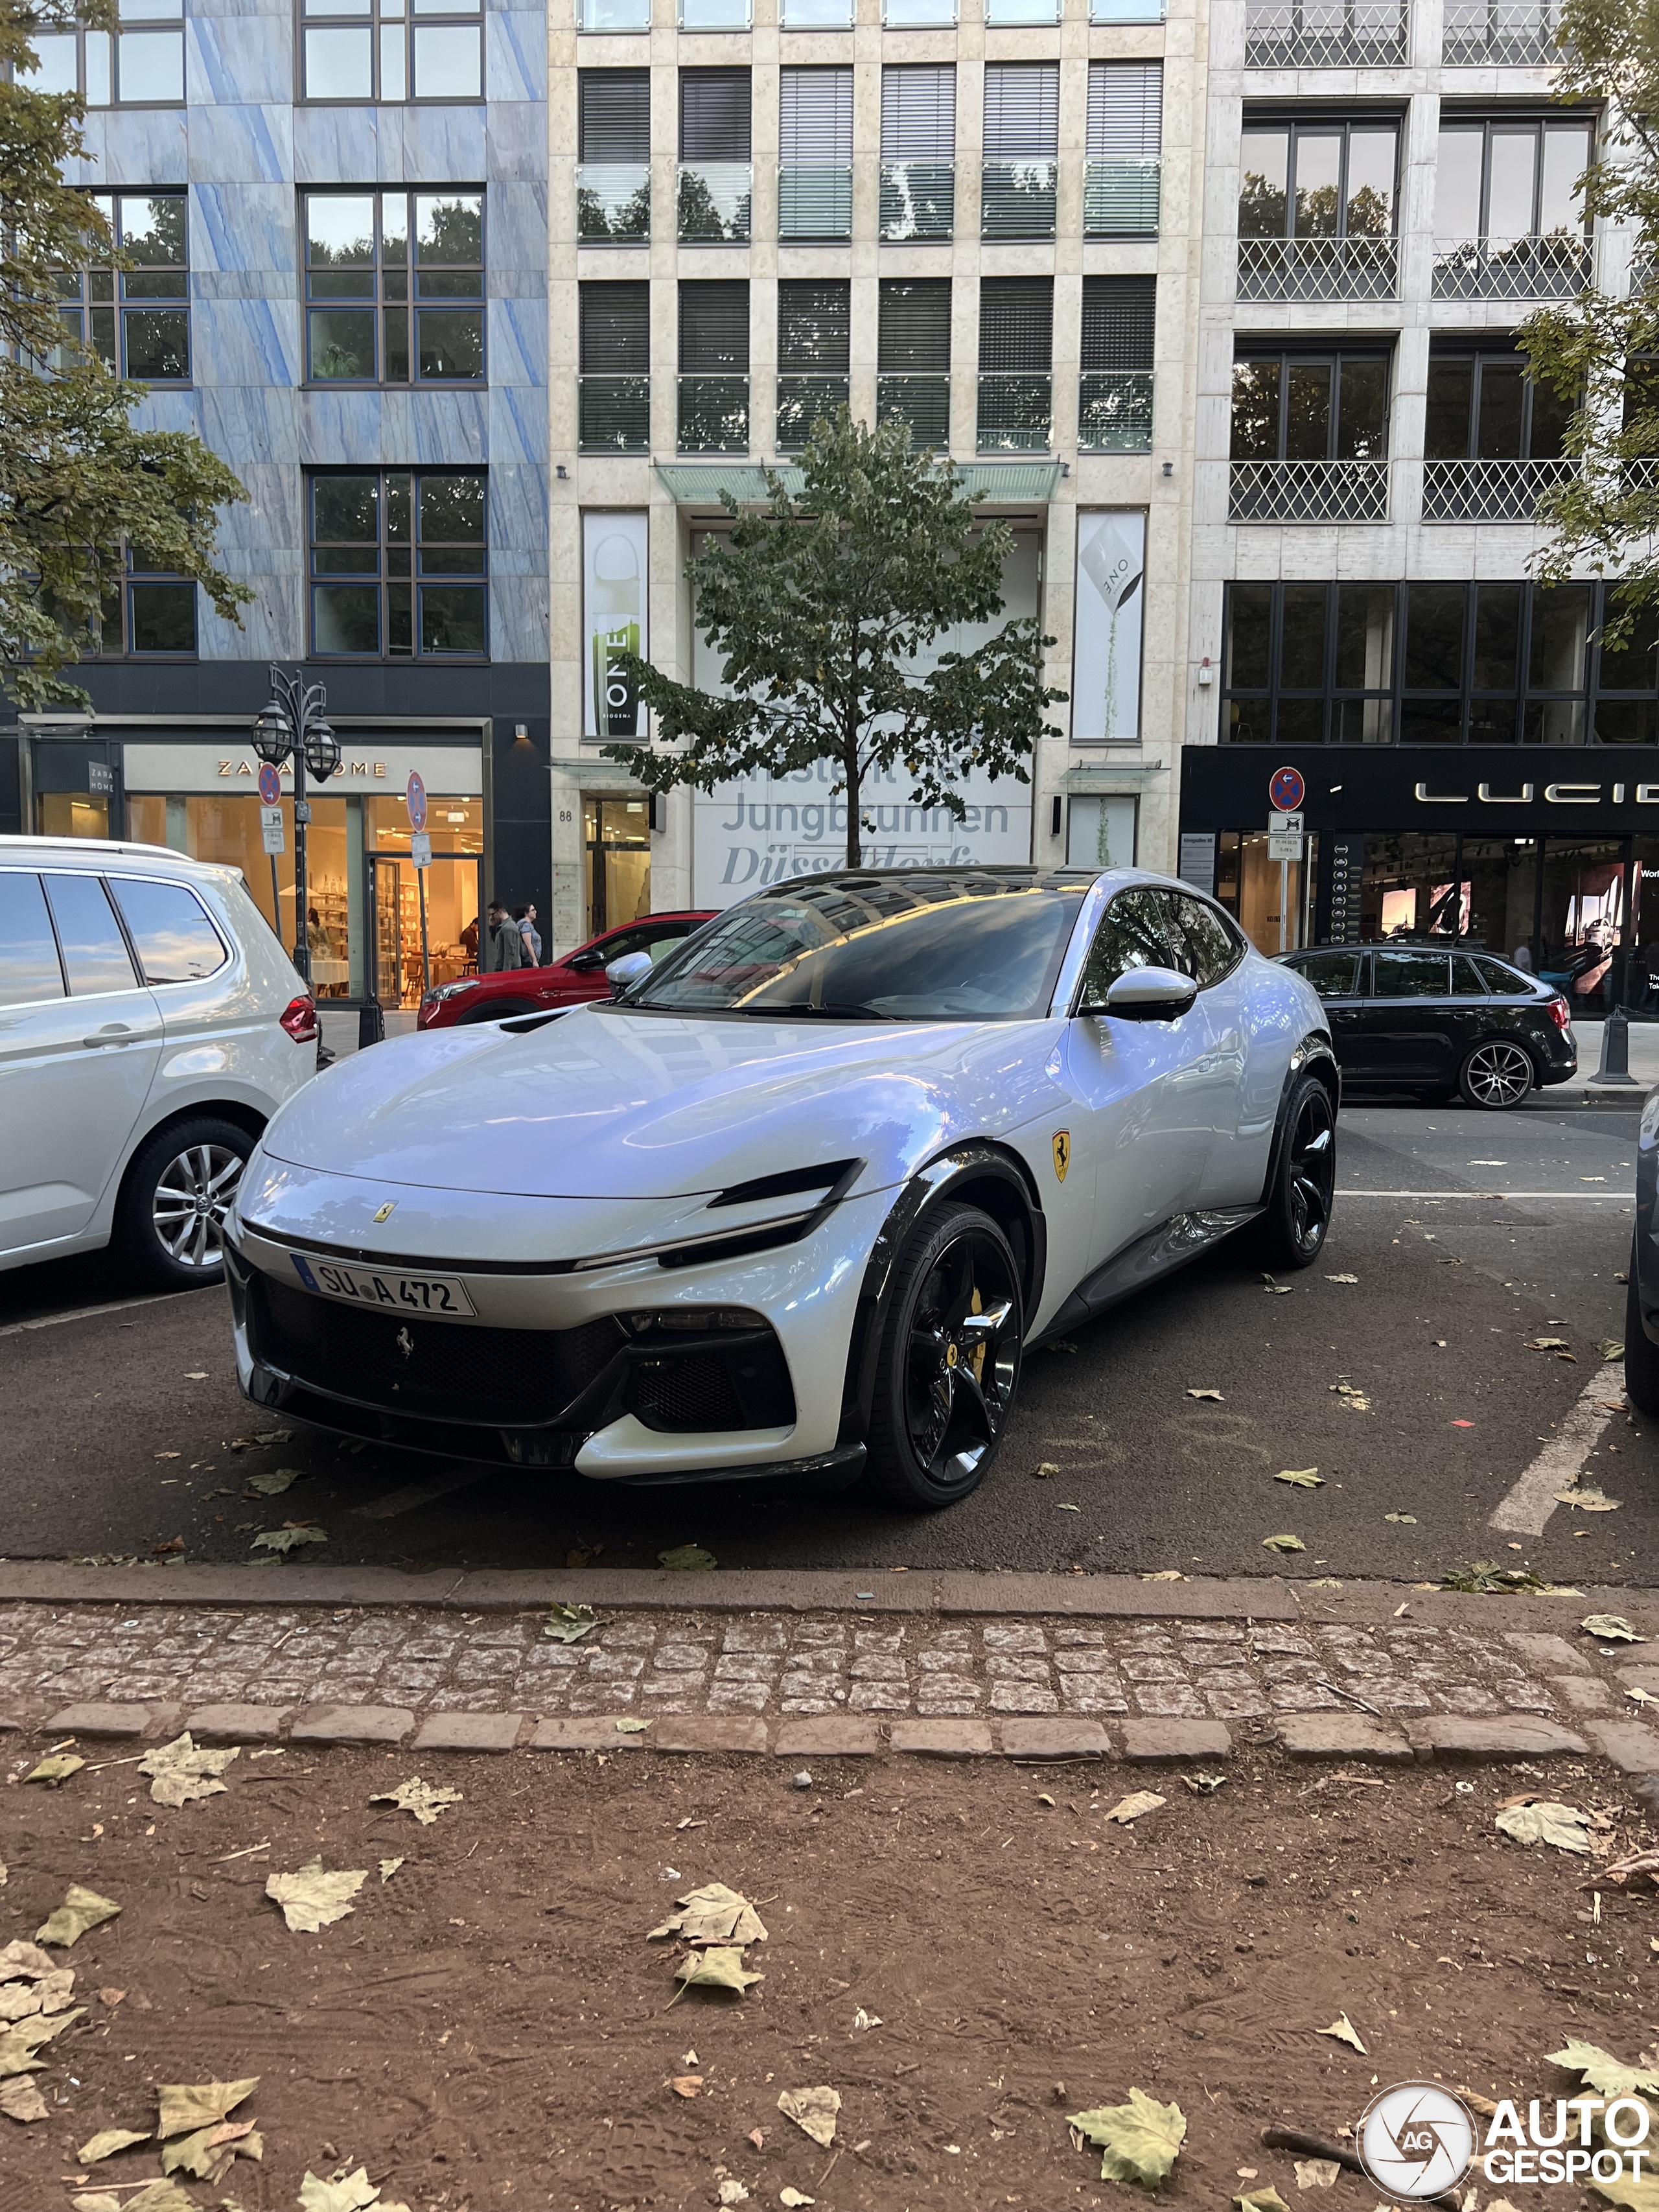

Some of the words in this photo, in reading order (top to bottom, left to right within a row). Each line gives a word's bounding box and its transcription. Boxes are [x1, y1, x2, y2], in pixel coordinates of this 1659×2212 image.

[1104, 559, 1128, 594] ONE
[92, 769, 113, 780] ZARA
[218, 761, 293, 776] ZAA
[91, 782, 114, 793] HOME
[559, 811, 572, 822] 88
[722, 793, 1008, 841] Jungbrunnen
[319, 1266, 360, 1297] SU
[372, 1276, 397, 1304] A
[399, 1280, 458, 1311] 472
